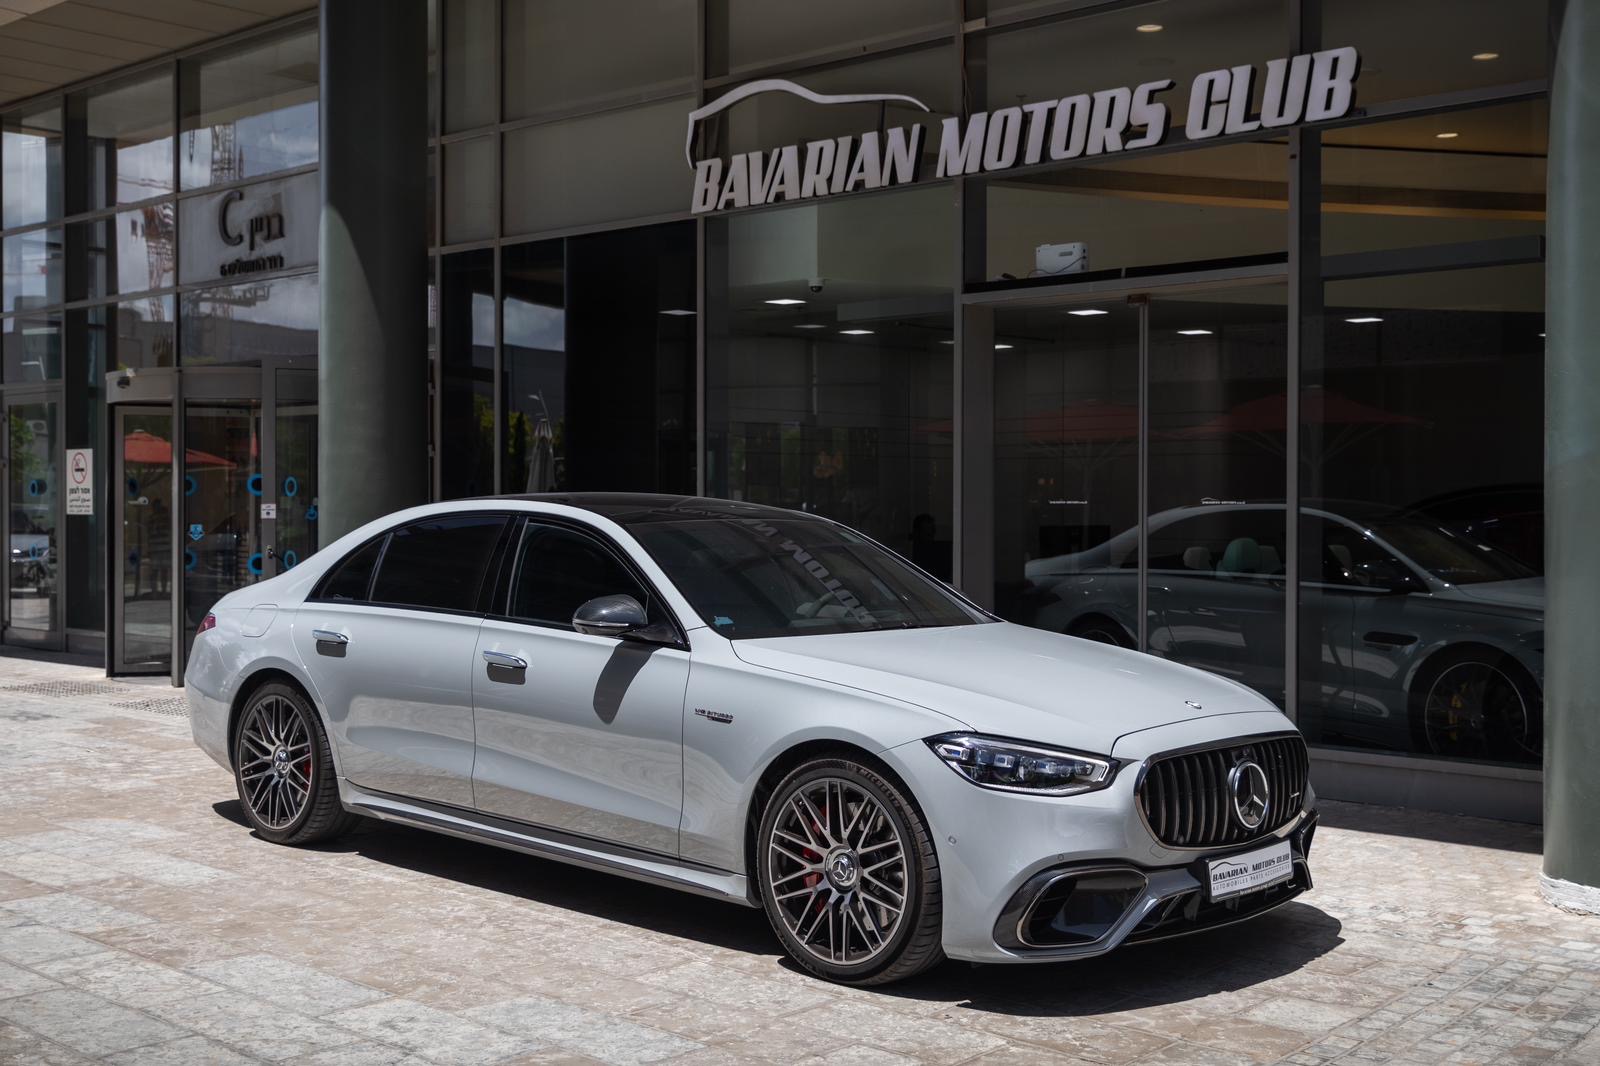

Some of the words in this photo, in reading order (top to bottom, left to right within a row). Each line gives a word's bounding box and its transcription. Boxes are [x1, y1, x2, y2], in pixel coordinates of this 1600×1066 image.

[691, 123, 924, 214] BAVARIAN
[937, 79, 1174, 178] MOTORS
[1186, 47, 1361, 140] CLUB
[218, 190, 244, 246] C
[248, 213, 286, 251] בניין
[1212, 865, 1249, 882] BAVARIAN
[1251, 858, 1276, 871] MOTORS
[1276, 853, 1290, 864] CLUB
[1212, 878, 1249, 891] AUTOMOBILES
